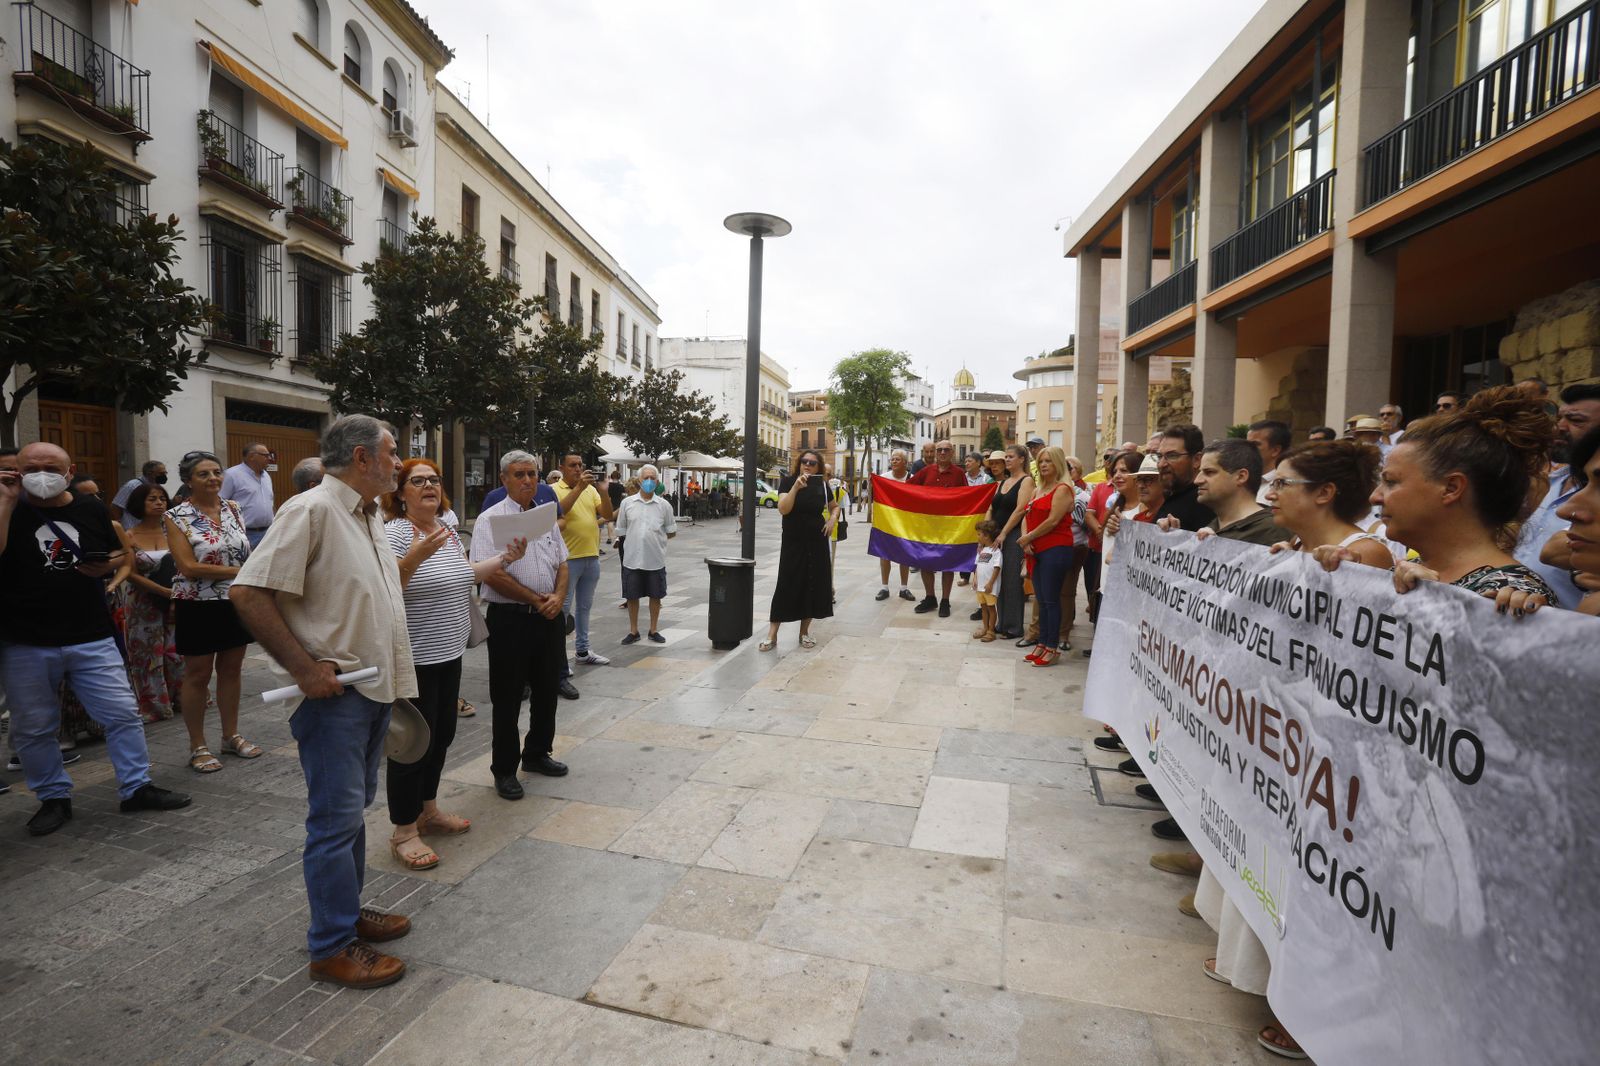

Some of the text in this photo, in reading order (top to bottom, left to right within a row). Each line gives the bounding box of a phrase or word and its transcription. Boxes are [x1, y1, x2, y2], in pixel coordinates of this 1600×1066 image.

[1127, 564, 1485, 785] EXHUMACIÓN DE VÍCTIMAS DEL FRANQUISMO
[1135, 539, 1447, 687] NO A LA PARALIZACIÓN MUNICIPAL DE LA
[1130, 652, 1143, 680] CON
[1143, 664, 1175, 721] VERDAD,
[1175, 701, 1232, 774] JUSTICIA
[1237, 752, 1248, 784] Y
[1253, 765, 1396, 951] REPARACIÓN
[1200, 787, 1247, 860] PLATAFORMA
[1300, 735, 1360, 843] YA!
[1222, 841, 1230, 863] DE
[1230, 850, 1237, 873] LA
